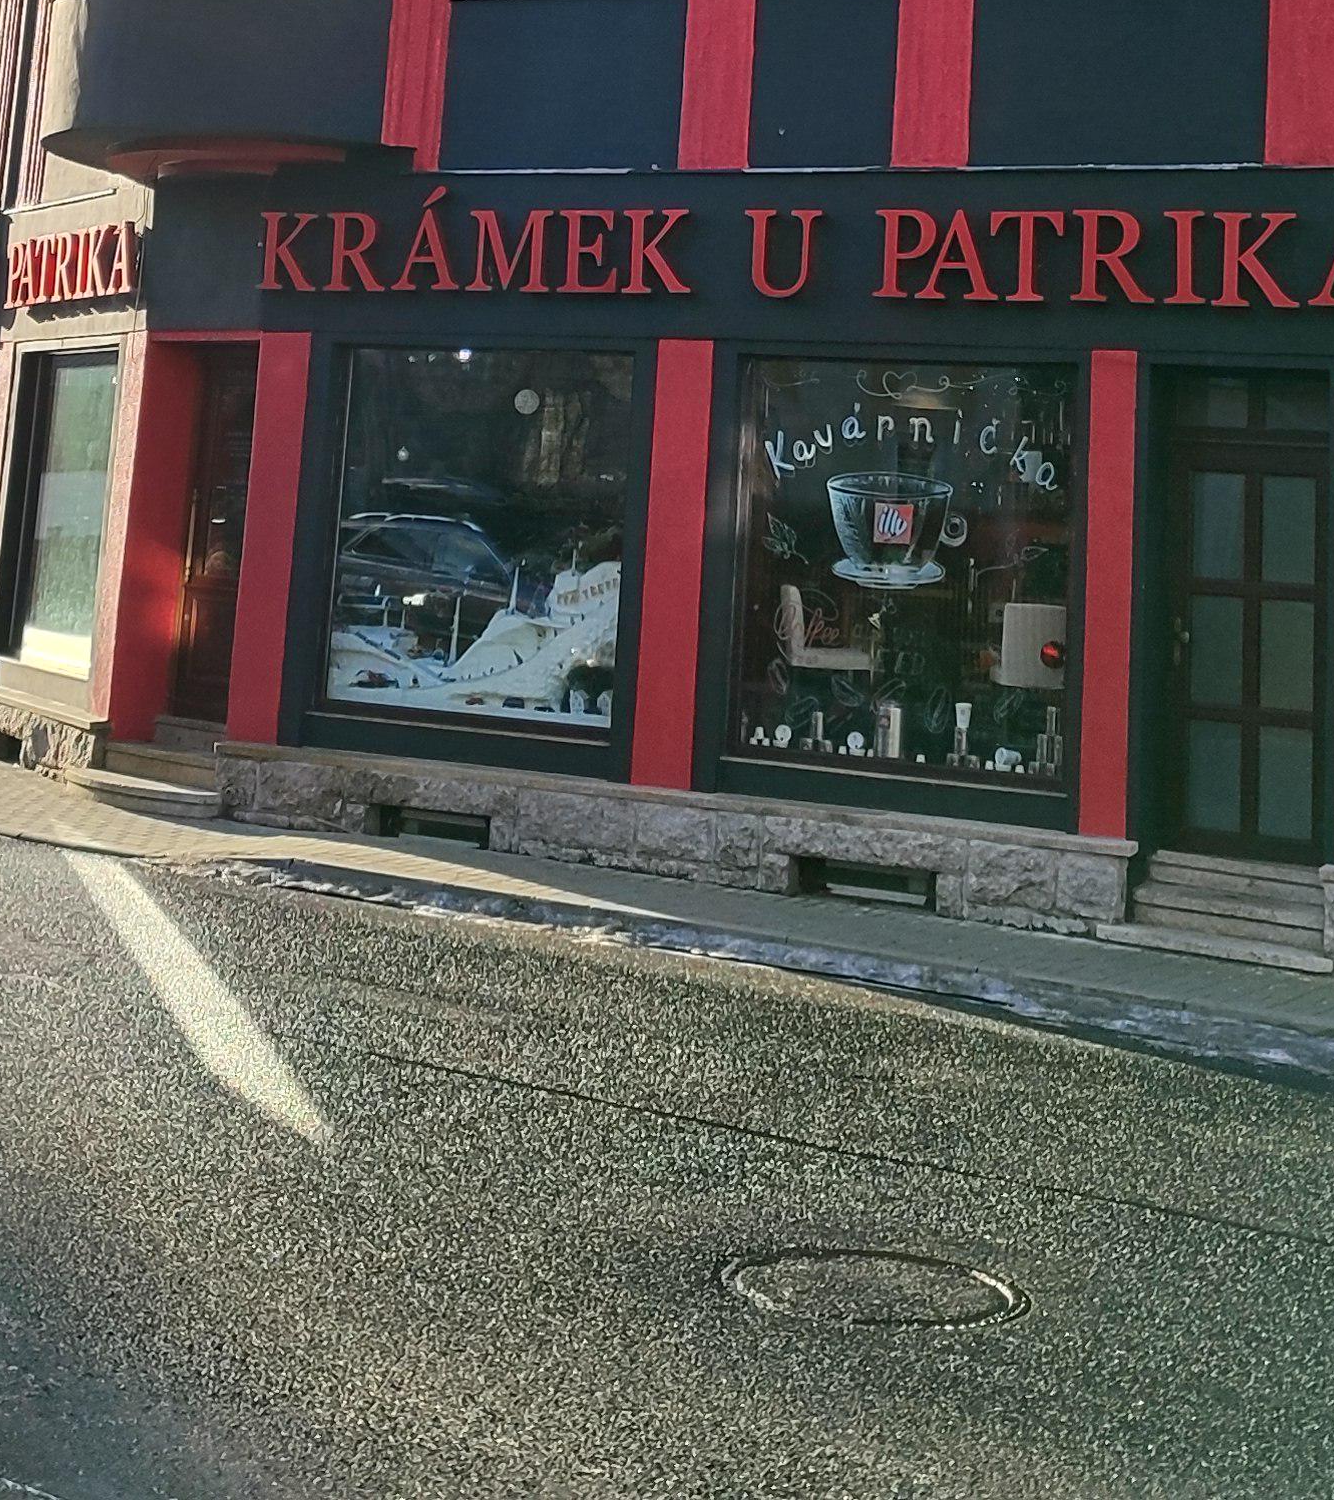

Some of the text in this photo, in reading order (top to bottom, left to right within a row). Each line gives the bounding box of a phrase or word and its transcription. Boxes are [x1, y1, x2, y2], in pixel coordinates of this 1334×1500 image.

[3, 221, 135, 309] PATRIKA
[257, 186, 691, 294] KRÁMEK
[745, 209, 824, 298] U
